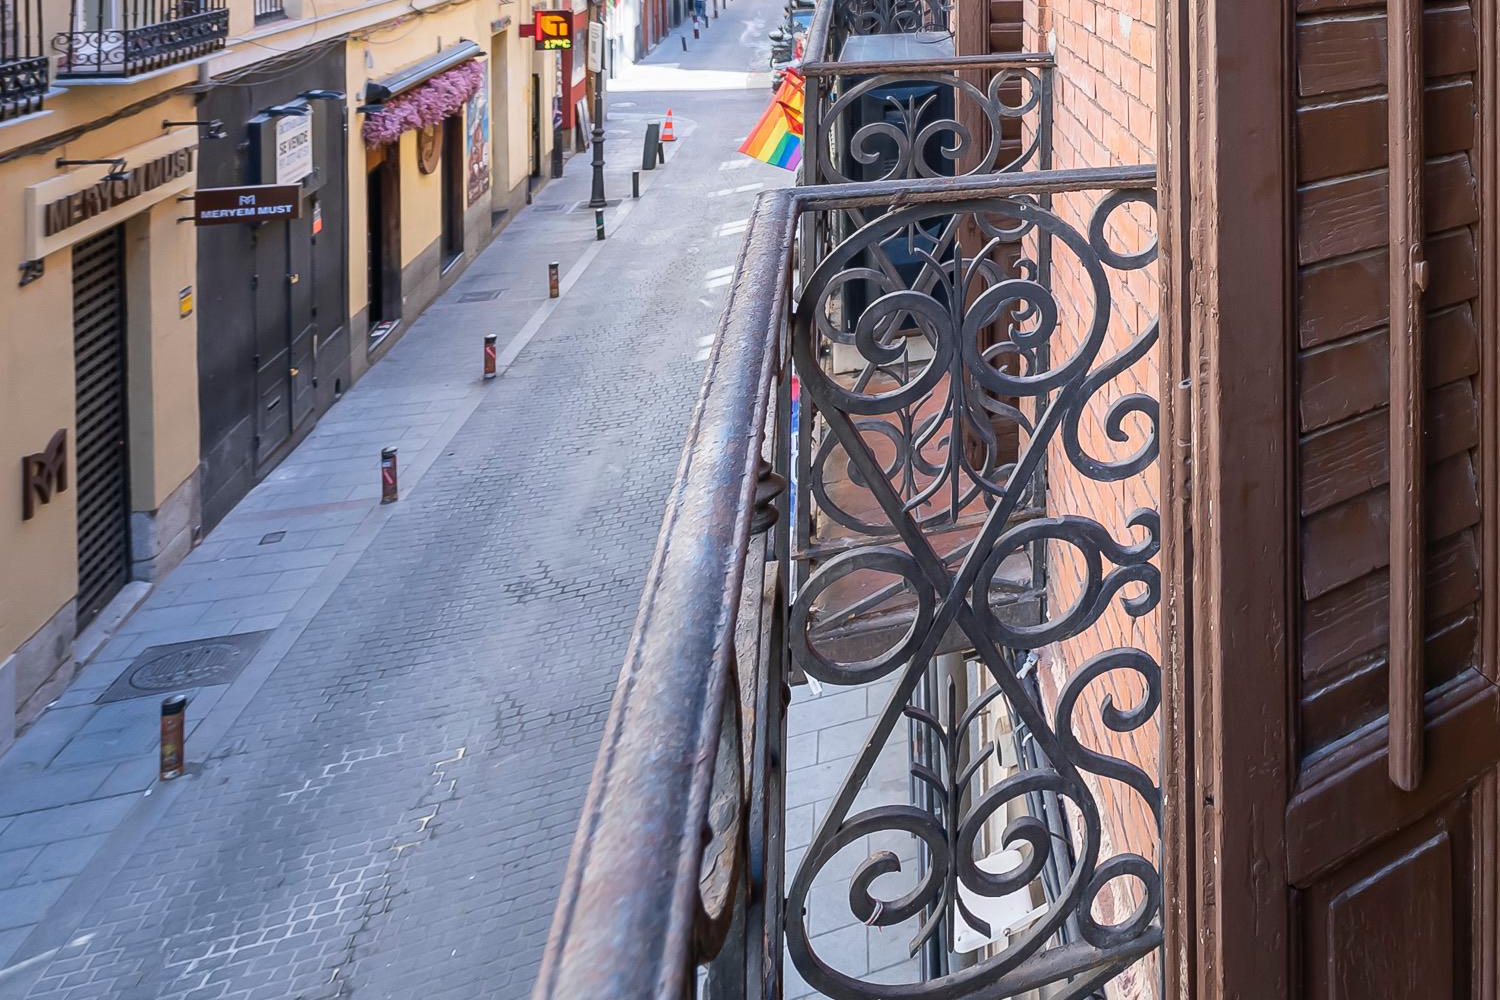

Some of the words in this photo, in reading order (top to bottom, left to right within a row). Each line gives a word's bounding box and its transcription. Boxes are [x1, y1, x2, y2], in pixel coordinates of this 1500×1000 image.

[44, 167, 143, 237] MERYEM
[144, 144, 198, 191] MUST
[200, 206, 256, 219] MERYEM
[257, 204, 293, 216] MUST
